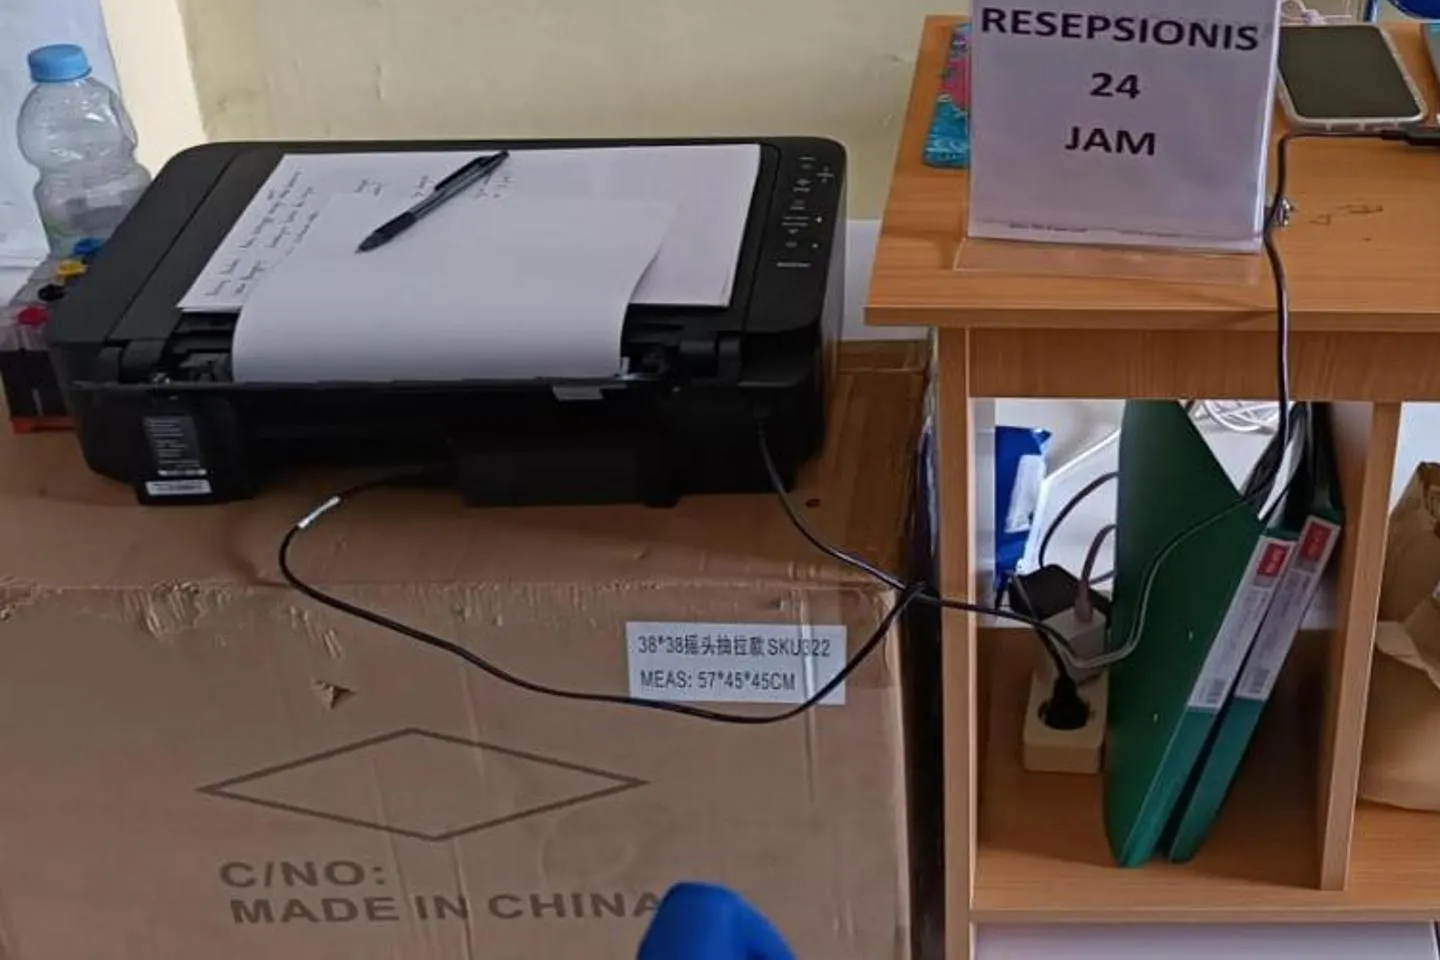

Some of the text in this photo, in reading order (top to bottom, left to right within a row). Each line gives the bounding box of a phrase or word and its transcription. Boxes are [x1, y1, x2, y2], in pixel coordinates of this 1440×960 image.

[981, 7, 1258, 51] RESEPSIONIS
[1090, 72, 1140, 99] 24
[1064, 126, 1156, 156] JAM
[640, 670, 692, 689] MEAS:
[220, 860, 385, 888] C/NO:
[230, 892, 661, 924] MADE IN CHINA
